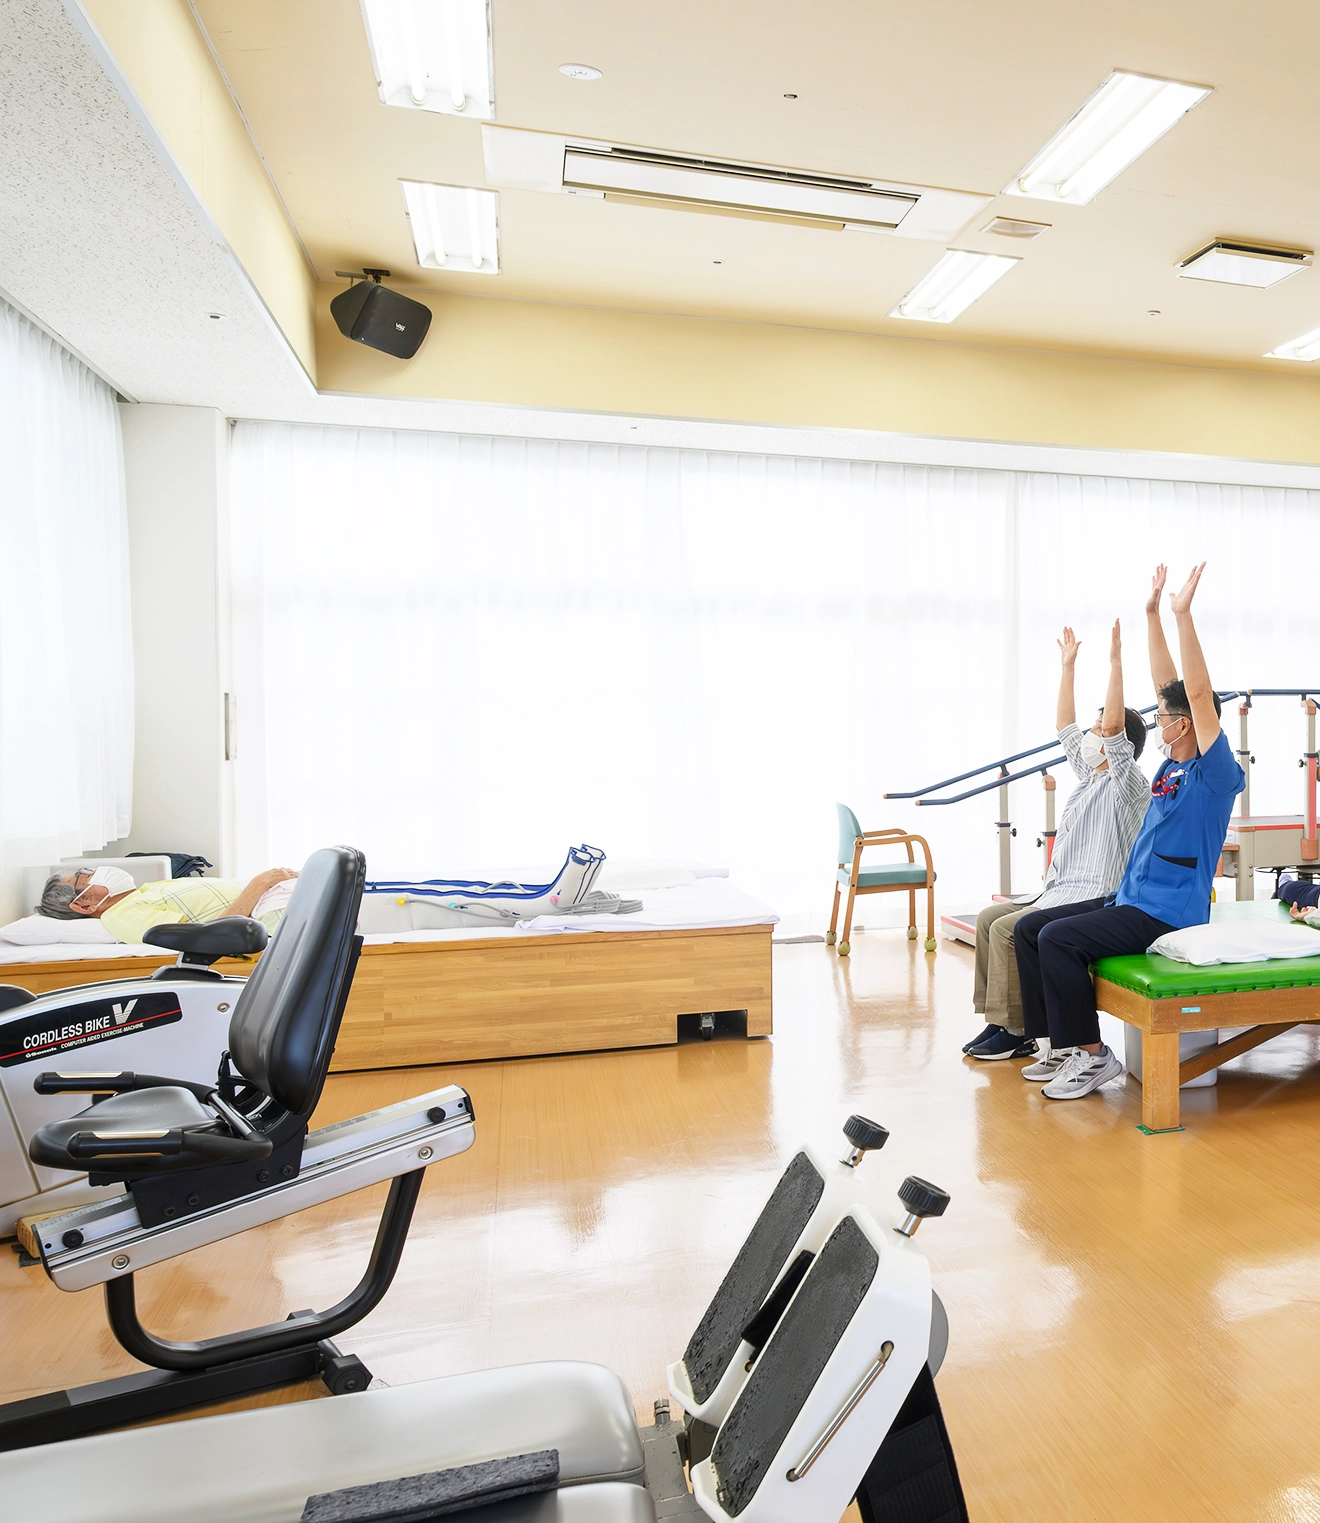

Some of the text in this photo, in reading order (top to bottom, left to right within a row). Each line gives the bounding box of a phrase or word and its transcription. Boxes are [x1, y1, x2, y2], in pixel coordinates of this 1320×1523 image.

[23, 998, 138, 1050] CORDLESS BIKE V
[60, 1022, 144, 1049] COMPUTER AIDED EXERCISE-MACHINE
